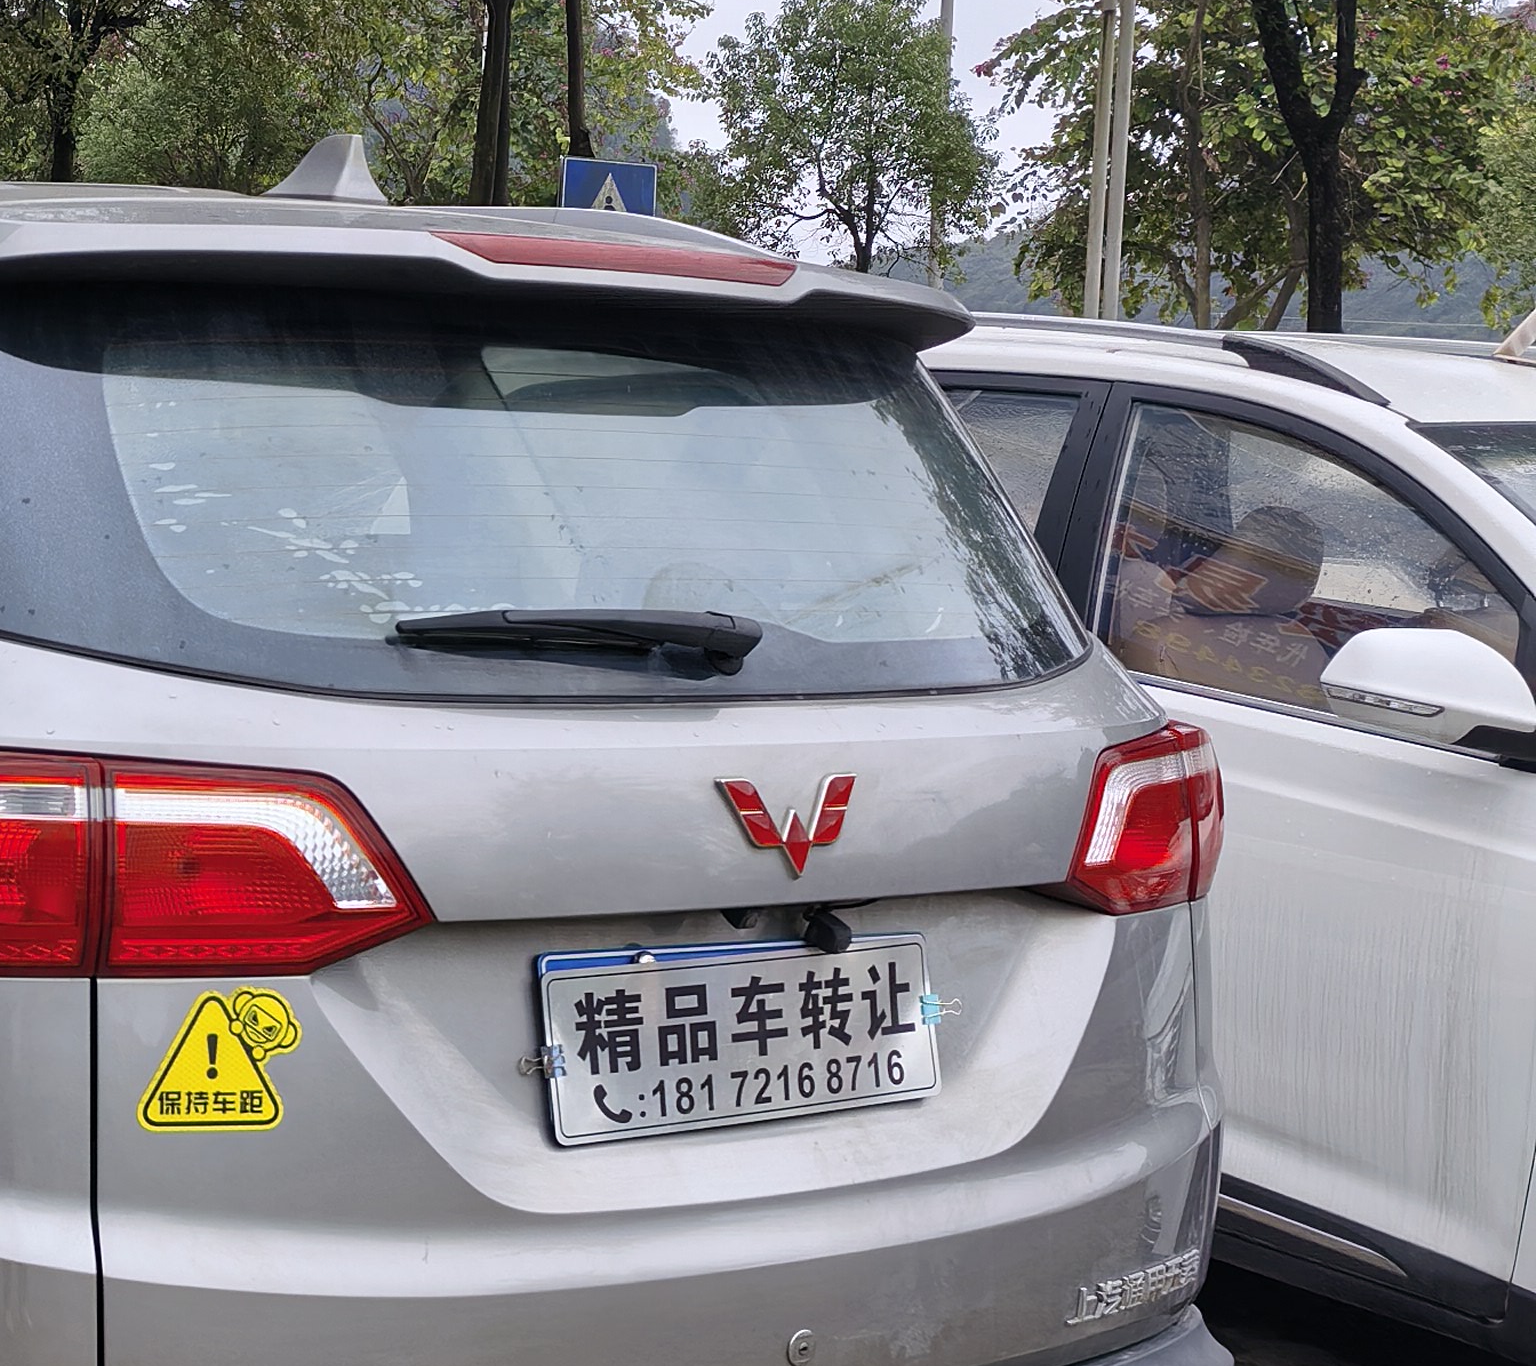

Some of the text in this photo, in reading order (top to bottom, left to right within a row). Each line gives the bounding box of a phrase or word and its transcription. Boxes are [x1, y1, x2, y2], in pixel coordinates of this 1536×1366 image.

[573, 961, 917, 1075] 精品车转让
[158, 1090, 263, 1115] 保持车距
